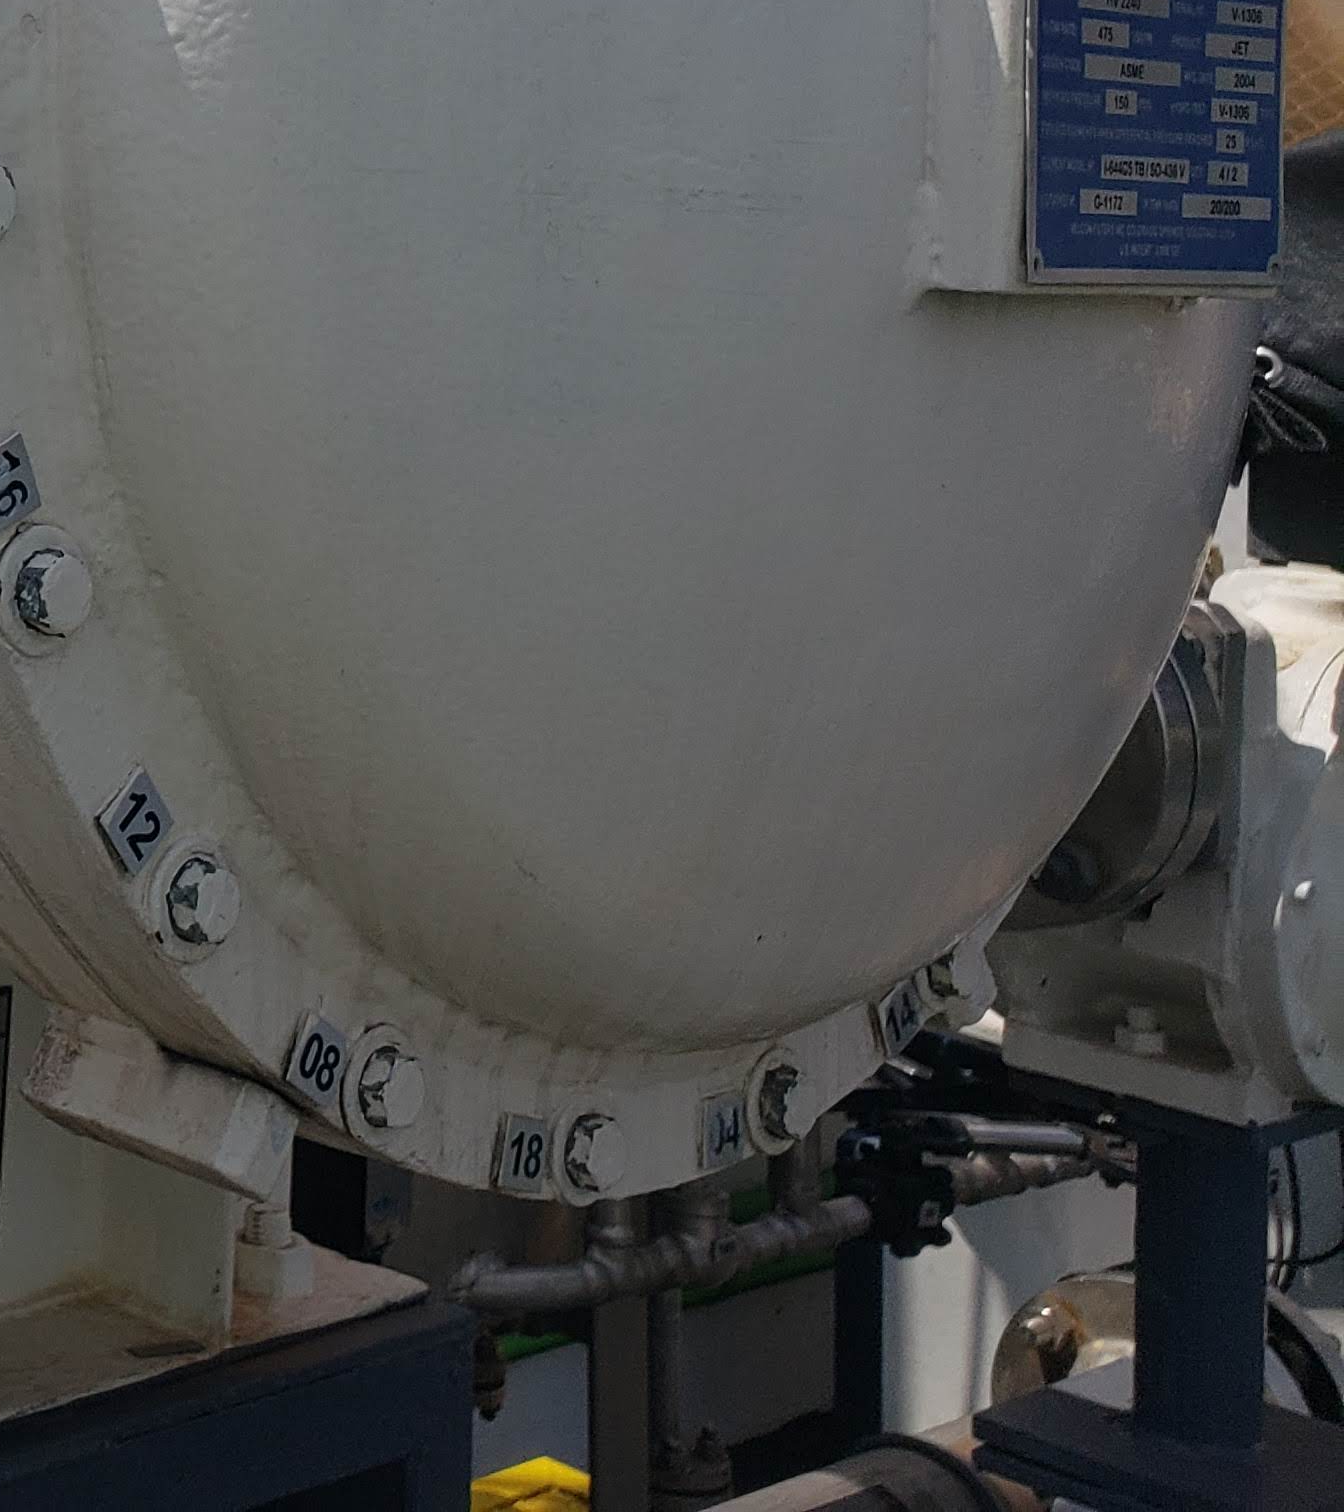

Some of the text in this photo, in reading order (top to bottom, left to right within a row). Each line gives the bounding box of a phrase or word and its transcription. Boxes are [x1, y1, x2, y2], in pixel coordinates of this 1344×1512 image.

[1231, 41, 1250, 56] JET
[117, 791, 161, 862] 12
[299, 1032, 341, 1092] 08
[511, 1131, 542, 1179] 18
